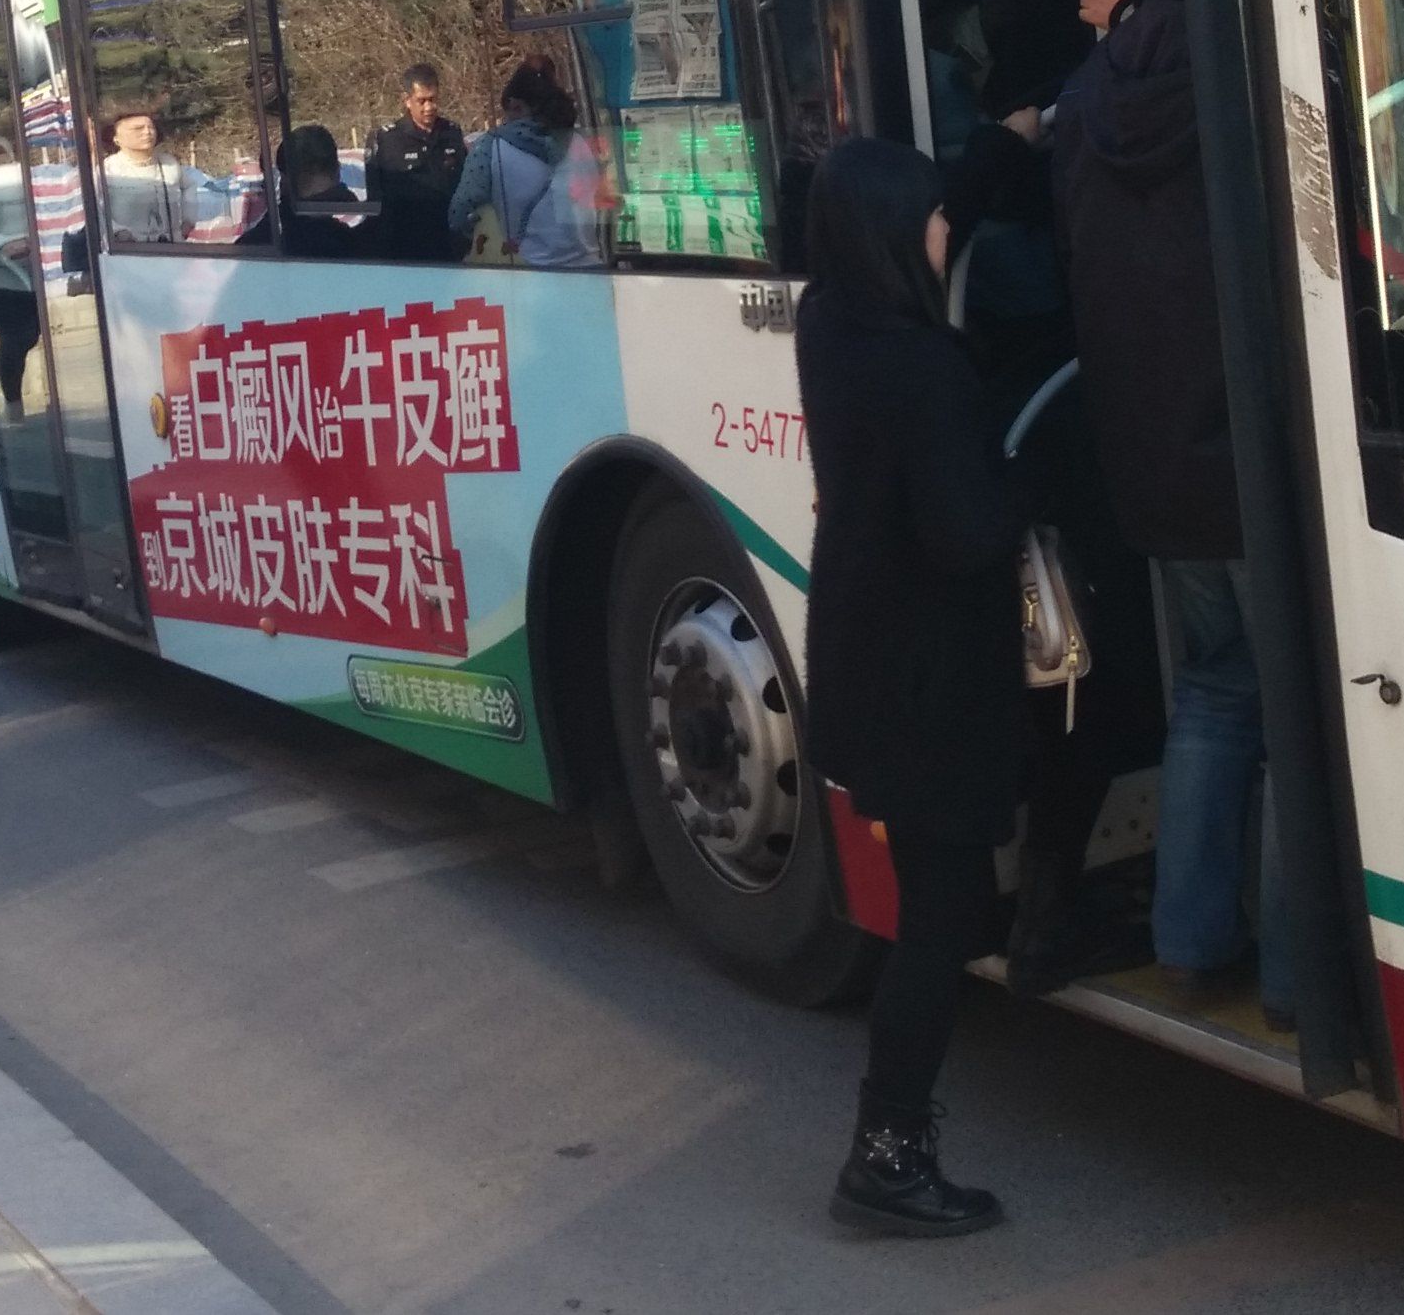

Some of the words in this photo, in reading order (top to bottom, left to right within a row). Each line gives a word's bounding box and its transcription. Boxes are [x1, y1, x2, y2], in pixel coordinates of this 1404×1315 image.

[169, 319, 506, 468] 看白癜风治牛皮癣
[141, 491, 455, 633] 到京城皮肤专科
